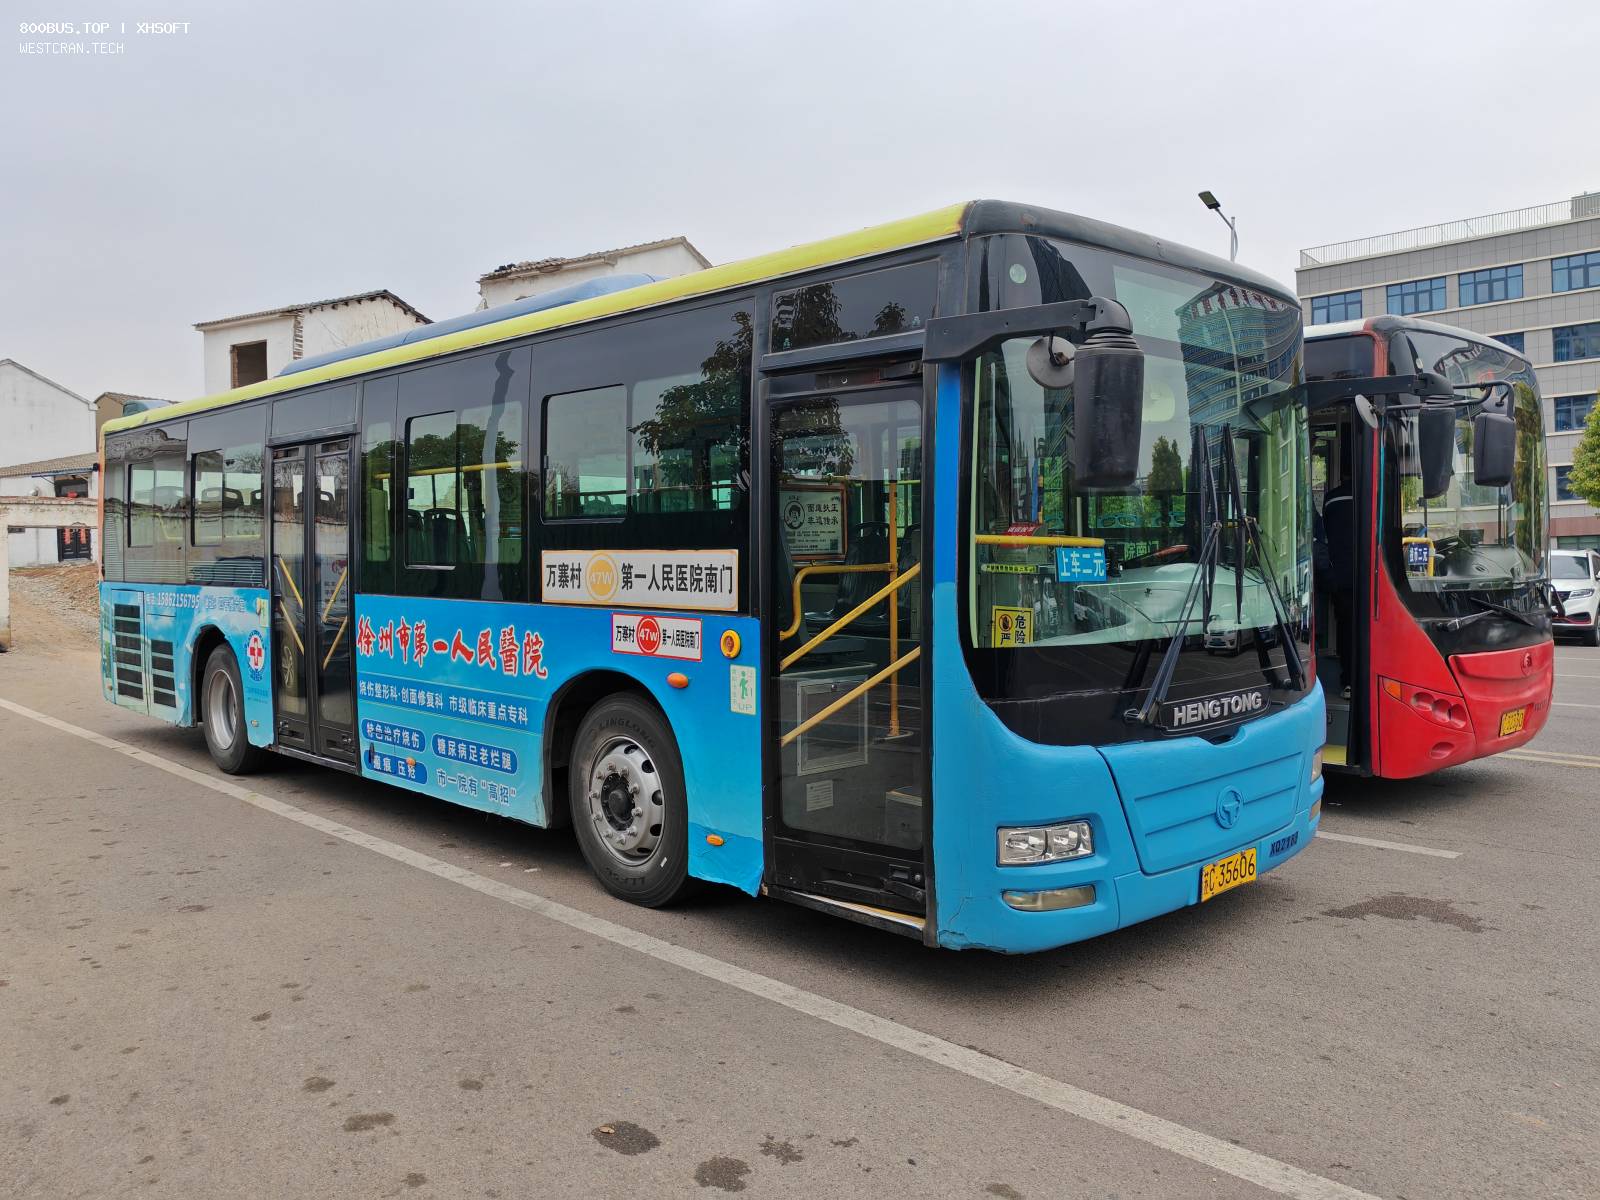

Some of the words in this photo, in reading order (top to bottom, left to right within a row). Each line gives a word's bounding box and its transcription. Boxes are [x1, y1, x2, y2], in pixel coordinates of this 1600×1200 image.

[545, 562, 582, 589] 万寨村
[621, 562, 733, 595] 第一人民医院南门
[1060, 550, 1106, 579] 上车二元
[615, 625, 635, 643] 万寨村
[639, 628, 658, 642] 47W
[662, 628, 700, 649] 第一人民医院南门
[1014, 614, 1027, 645] 危险
[448, 695, 529, 726] 市级临床重点专科
[1173, 691, 1262, 727] HENGTONG
[366, 721, 420, 749] 特色治疗烧伤
[437, 737, 512, 771] 糖尿病足老烂腿
